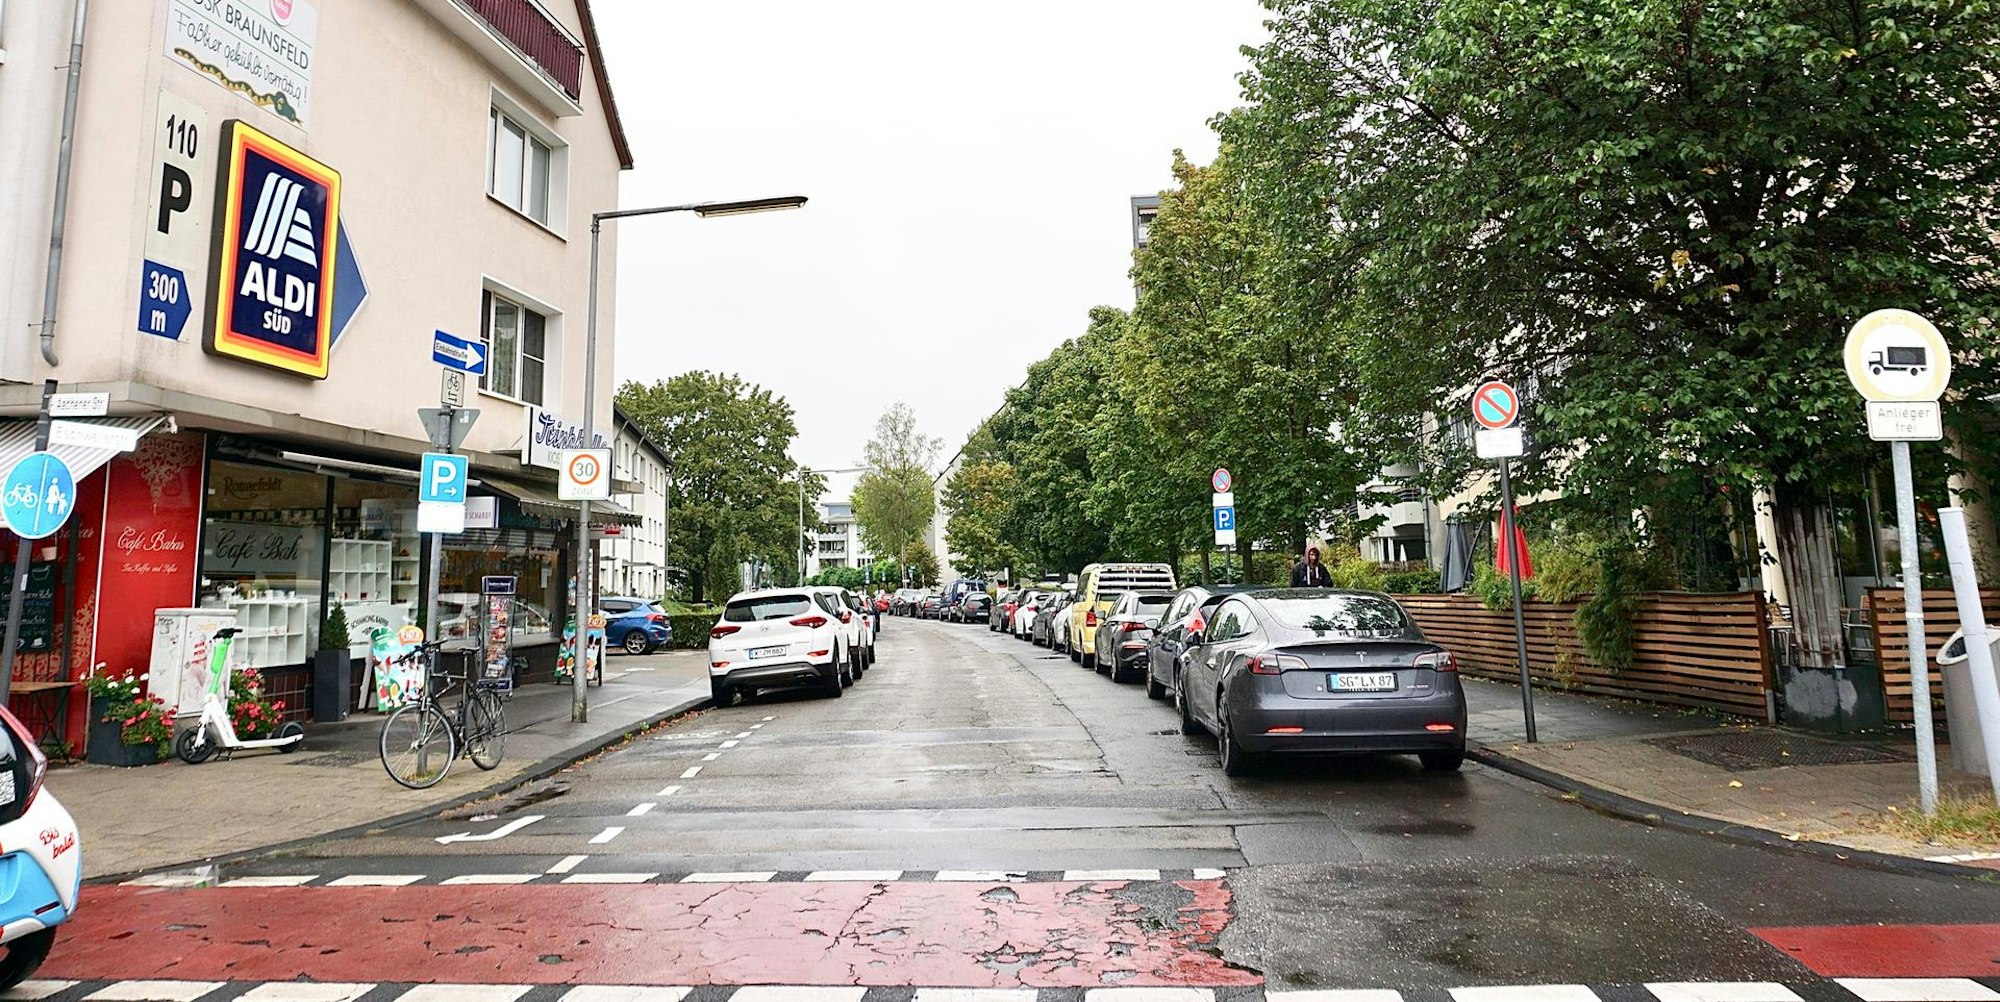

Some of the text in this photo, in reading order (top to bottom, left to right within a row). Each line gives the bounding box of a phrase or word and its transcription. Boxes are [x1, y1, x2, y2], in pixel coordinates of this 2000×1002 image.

[174, 8, 222, 51] Faßbier
[224, 42, 262, 78] gekühlt
[225, 4, 309, 70] BRAUNSFELD
[166, 114, 198, 159] 110
[157, 162, 192, 235] P
[149, 270, 179, 304] 300
[240, 260, 316, 318] ALDI
[151, 309, 166, 333] m
[263, 308, 292, 335] SÜD
[1878, 407, 1931, 421] Anlieger
[1895, 422, 1918, 433] frei
[430, 459, 457, 497] P
[575, 462, 594, 477] 30
[1218, 509, 1230, 529] P
[117, 525, 146, 556] Café
[215, 527, 256, 569] Café
[1339, 675, 1354, 688] SG
[1378, 675, 1392, 687] 87
